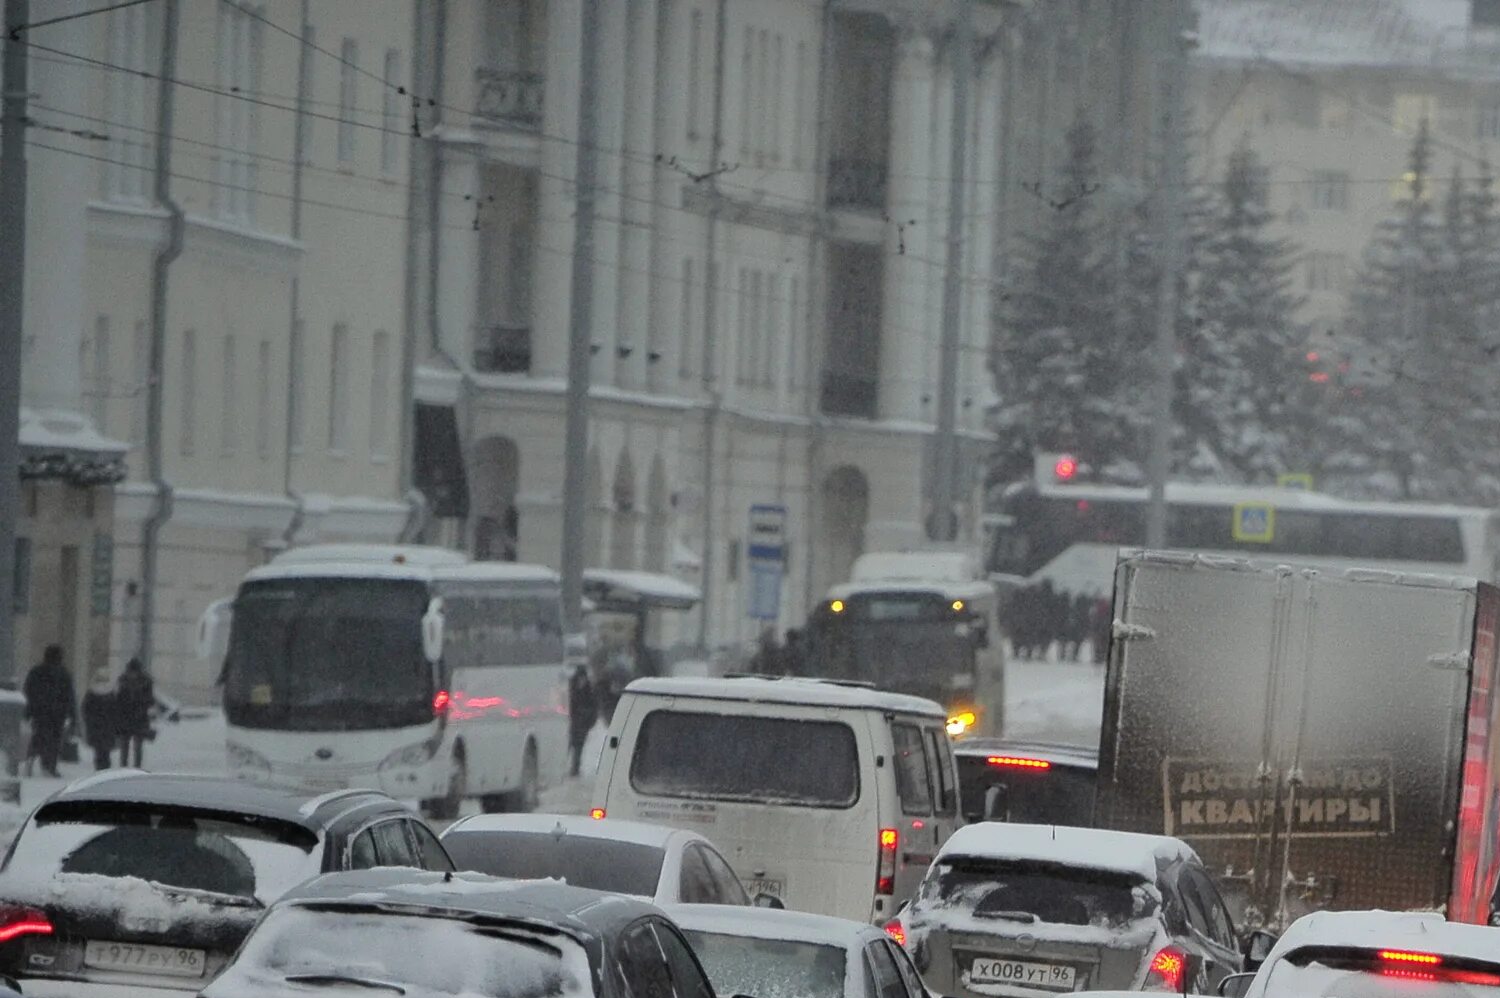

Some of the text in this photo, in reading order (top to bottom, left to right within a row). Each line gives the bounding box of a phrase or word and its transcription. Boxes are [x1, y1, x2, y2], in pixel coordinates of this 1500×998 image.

[1181, 797, 1381, 825] КВАРТИРЫ
[95, 945, 197, 967] Т977РУ 96
[980, 962, 1069, 982] Х008УТ 96
